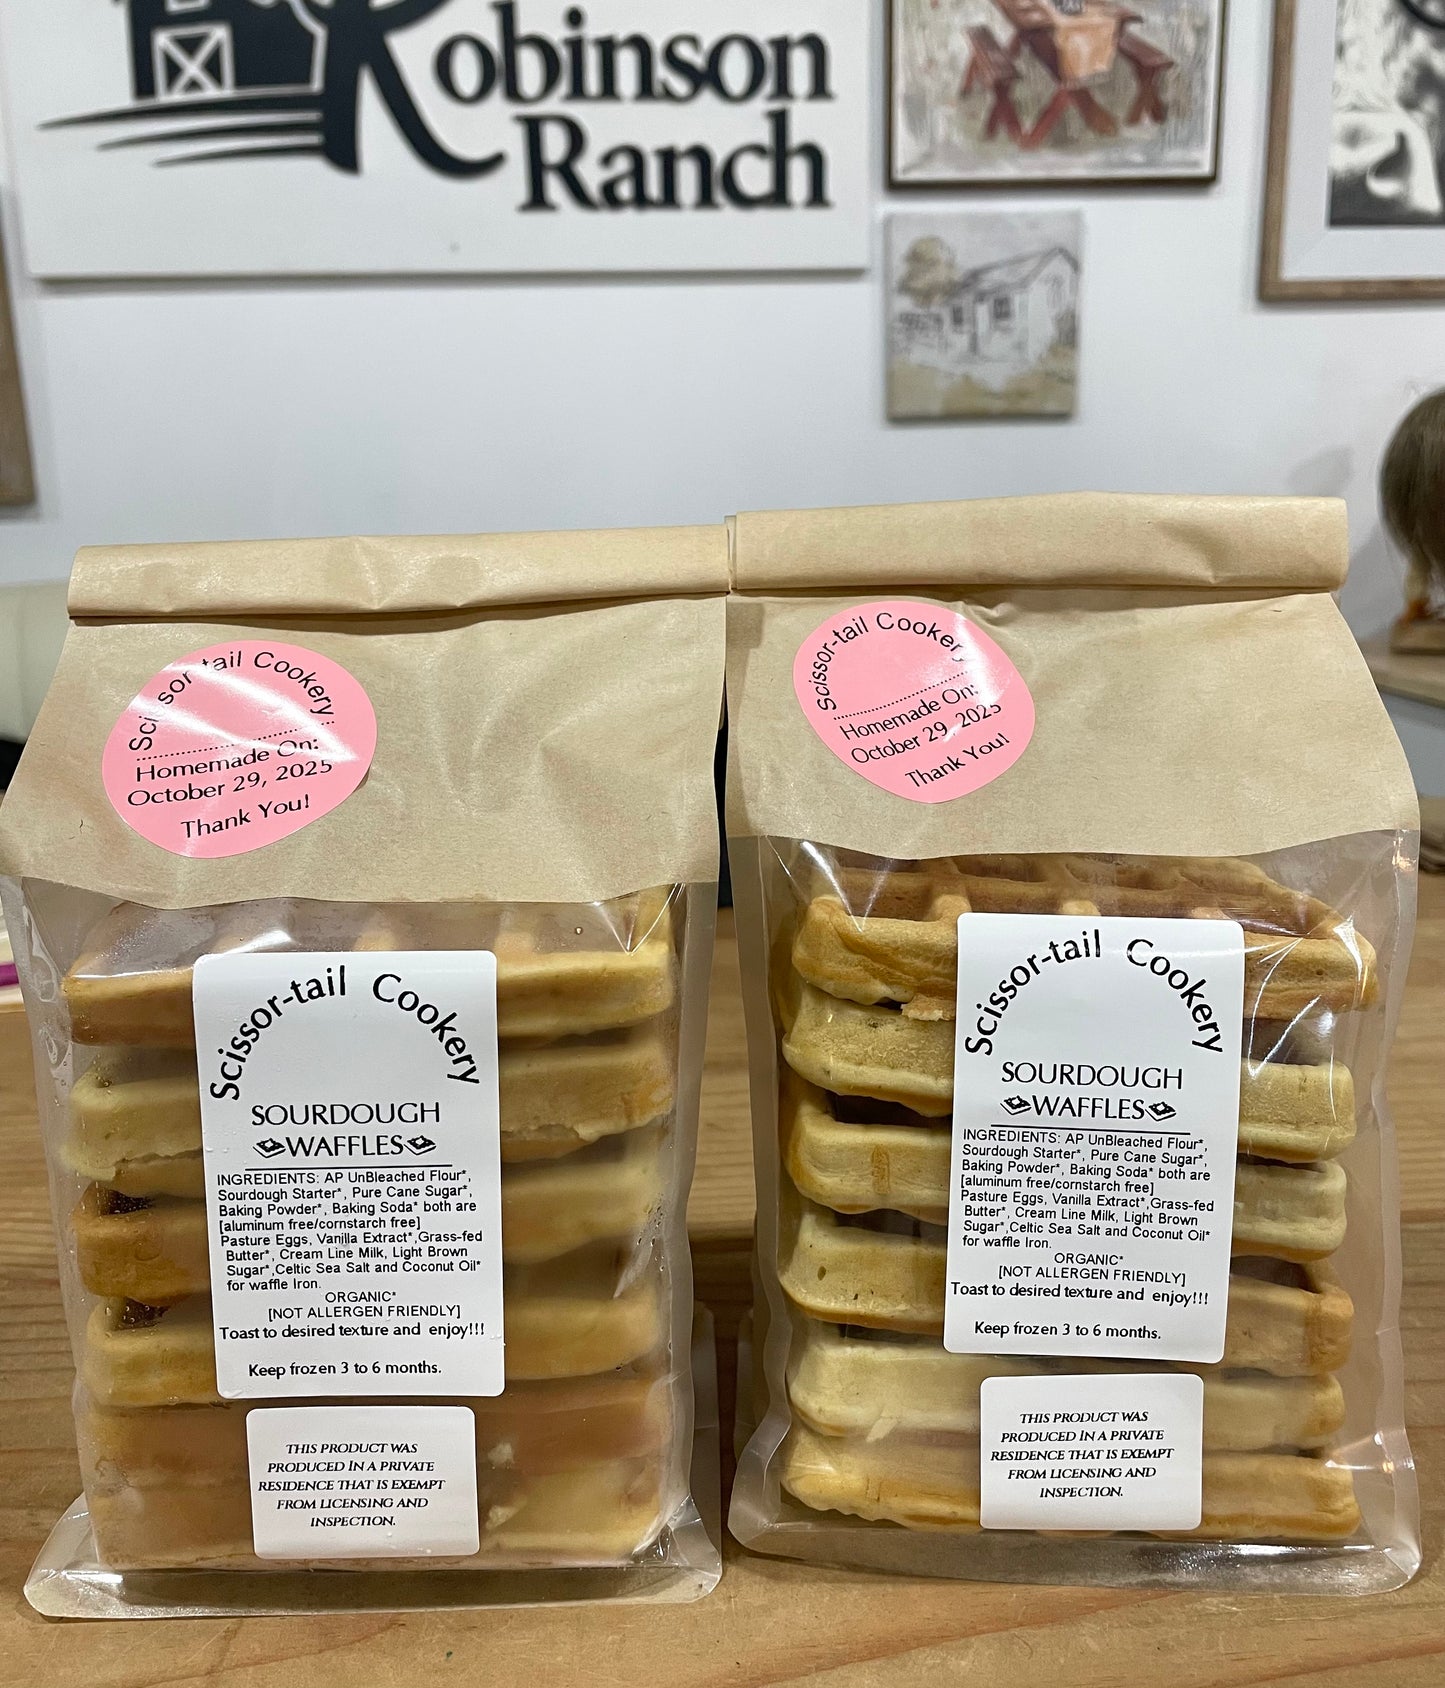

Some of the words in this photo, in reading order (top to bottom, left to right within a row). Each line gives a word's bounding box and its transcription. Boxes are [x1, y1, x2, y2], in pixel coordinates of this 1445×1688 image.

[322, 0, 833, 177] Robinson
[515, 109, 833, 213] Ranch
[808, 616, 868, 711] Scissor-tail
[253, 652, 334, 716] Cookery
[840, 699, 941, 740] Homemade
[942, 685, 979, 704] On:
[851, 734, 921, 763] October
[136, 748, 270, 782] Homemade
[277, 739, 318, 757] On:
[905, 756, 966, 788] Thank
[963, 733, 1009, 760] You!
[127, 782, 225, 806] October
[233, 772, 266, 792] 29,
[276, 760, 332, 781] 2025
[181, 809, 251, 839] Thank
[258, 794, 309, 818] You!
[965, 929, 1101, 1056] Scissor-tail
[1126, 938, 1223, 1053] Cookery
[210, 964, 346, 1100] Scissor-tail
[372, 973, 480, 1084] Cookery
[1001, 1061, 1182, 1089] SOURDOUGH
[251, 1102, 440, 1126] SOURDOUGH
[1031, 1095, 1145, 1120] WAFFLES
[286, 1134, 403, 1156] WAFFLES
[963, 1129, 1060, 1143] INGREDIENTS:
[1065, 1133, 1084, 1144] AP
[1089, 1134, 1162, 1148] UnBleached
[962, 1144, 1028, 1159] Sourdough
[1091, 1149, 1119, 1161] Pure
[1124, 1151, 1156, 1163] Cane
[217, 1172, 319, 1185] INGREDIENTS:
[324, 1172, 343, 1183] AP
[348, 1171, 425, 1182] UnBleached
[962, 1159, 1002, 1174] Baking
[1070, 1164, 1111, 1179] Baking
[1159, 1168, 1185, 1179] both
[1190, 1171, 1210, 1180] are
[218, 1189, 288, 1202] Sourdough
[353, 1187, 381, 1198] Pure
[387, 1186, 420, 1197] Cane
[961, 1175, 1021, 1188] [aluminum
[1026, 1177, 1120, 1191] free/cornstarch
[1125, 1181, 1154, 1196] free]
[961, 1190, 1007, 1202] Pasture
[1013, 1192, 1047, 1205] Eggs,
[1052, 1193, 1091, 1205] Vanilla
[219, 1205, 262, 1218] Baking
[332, 1202, 375, 1216] Baking
[424, 1200, 451, 1212] both
[456, 1202, 476, 1211] are
[1015, 1207, 1056, 1218] Cream
[1062, 1209, 1086, 1220] Line
[1091, 1210, 1118, 1223] Milk,
[1125, 1211, 1153, 1225] Light
[1159, 1213, 1197, 1225] Brown
[220, 1220, 284, 1234] [aluminum
[288, 1217, 386, 1229] free/cornstarch
[391, 1216, 420, 1230] free]
[1048, 1223, 1071, 1234] Sea
[1078, 1224, 1100, 1235] Salt
[1105, 1226, 1127, 1237] and
[1132, 1226, 1183, 1239] Coconut
[221, 1236, 270, 1246] Pasture
[276, 1234, 312, 1247] Eggs,
[317, 1233, 357, 1244] Vanilla
[963, 1235, 979, 1246] for
[984, 1236, 1020, 1247] waffle
[1026, 1237, 1051, 1248] Iron.
[280, 1249, 322, 1259] Cream
[328, 1248, 353, 1258] Line
[359, 1247, 387, 1259] Milk,
[393, 1247, 422, 1260] Light
[428, 1246, 467, 1256] Brown
[316, 1263, 341, 1273] Sea
[346, 1262, 370, 1273] Salt
[375, 1262, 397, 1272] and
[402, 1261, 454, 1272] Coconut
[227, 1280, 244, 1291] for
[249, 1279, 288, 1290] waffle
[293, 1278, 321, 1289] Iron.
[999, 1266, 1031, 1279] [NOT
[1036, 1267, 1109, 1280] ALLERGEN
[1113, 1269, 1186, 1287] FRIENDLY]
[951, 1282, 988, 1296] Toast
[992, 1284, 1005, 1296] to
[1010, 1283, 1060, 1297] desired
[1064, 1286, 1113, 1299] texture
[1117, 1288, 1144, 1300] and
[1152, 1291, 1208, 1307] enjoy!!!
[268, 1307, 303, 1322] [NOT
[307, 1306, 383, 1318] ALLERGEN
[387, 1304, 460, 1318] FRIENDLY]
[220, 1327, 259, 1340] Toast
[263, 1327, 277, 1339] to
[282, 1324, 335, 1338] desired
[339, 1324, 389, 1336] texture
[393, 1323, 421, 1336] and
[429, 1323, 485, 1339] enjoy!!!
[975, 1321, 1009, 1338] Keep
[1014, 1321, 1057, 1335] frozen
[1075, 1324, 1088, 1335] to
[1106, 1326, 1160, 1339] months.
[249, 1364, 285, 1380] Keep
[290, 1362, 336, 1375] frozen
[354, 1362, 368, 1374] to
[386, 1361, 442, 1374] months.
[1020, 1413, 1050, 1423] THIS
[1053, 1412, 1119, 1423] PRODUCT
[1122, 1411, 1149, 1422] WAS
[1001, 1431, 1076, 1442] PRODUCED
[1079, 1430, 1095, 1441] IN
[1110, 1430, 1164, 1441] PRIVATE
[286, 1443, 317, 1454] THIS
[320, 1443, 388, 1454] PRODUCT
[391, 1443, 418, 1453] WAS
[991, 1451, 1065, 1461] RESIDENCE
[1068, 1450, 1104, 1460] THAT
[1120, 1449, 1174, 1459] EXEMPT
[267, 1462, 344, 1473] PRODUCED
[348, 1460, 364, 1471] IN
[380, 1461, 434, 1471] PRIVATE
[1008, 1469, 1046, 1479] FROM
[1050, 1468, 1122, 1479] LICENSING
[1125, 1467, 1156, 1477] AND
[258, 1480, 334, 1491] RESIDENCE
[337, 1480, 374, 1490] THAT
[376, 1480, 388, 1489] IS
[391, 1479, 446, 1490] EXEMPT
[1040, 1487, 1123, 1498] INSPECTION.
[277, 1499, 316, 1509] FROM
[320, 1498, 394, 1509] LICENSING
[397, 1498, 428, 1508] AND
[310, 1516, 396, 1527] INSPECTION.
